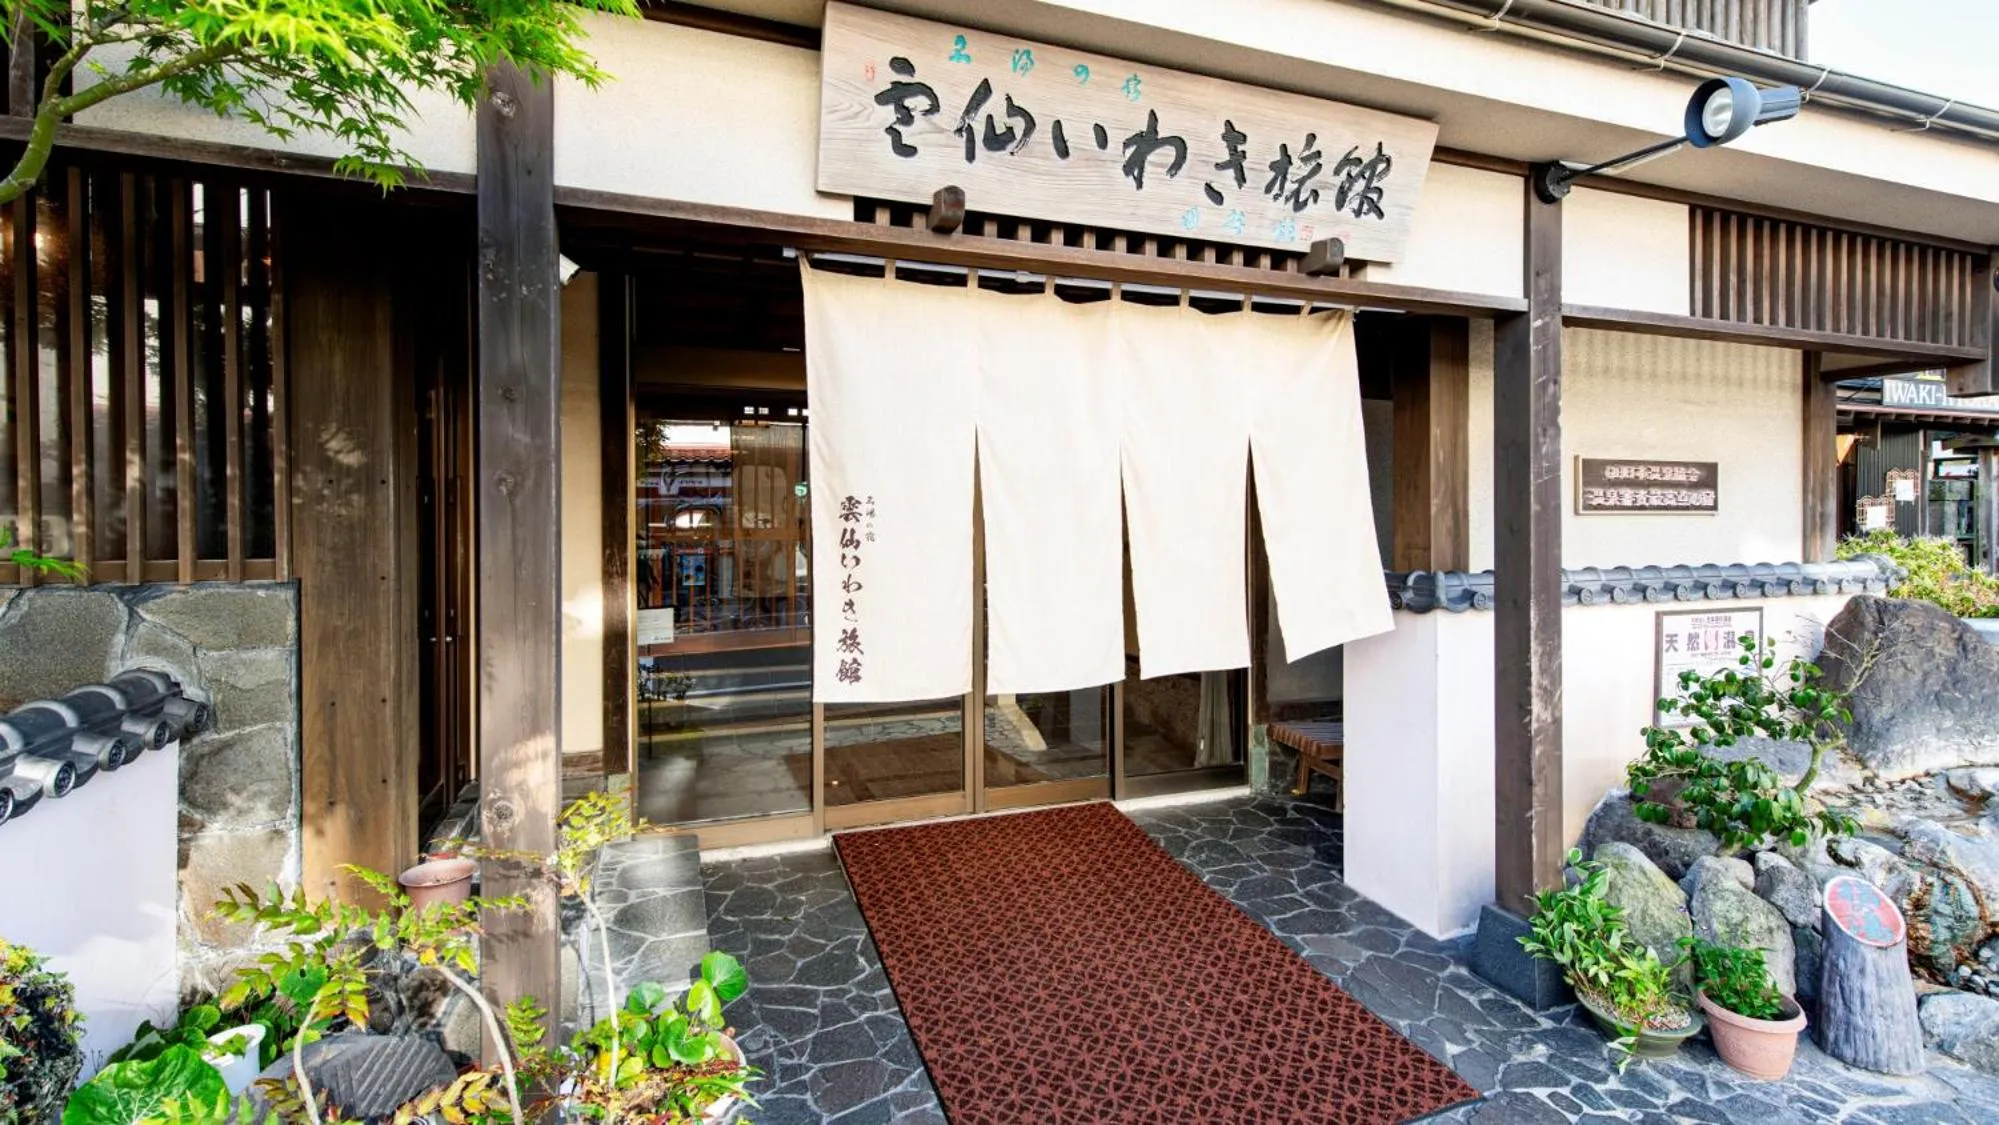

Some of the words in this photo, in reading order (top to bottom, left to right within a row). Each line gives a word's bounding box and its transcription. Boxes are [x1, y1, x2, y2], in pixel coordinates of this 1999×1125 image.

[875, 56, 1393, 221] 雲仙いわき旅館
[836, 495, 864, 686] 雲仙いわき旅館
